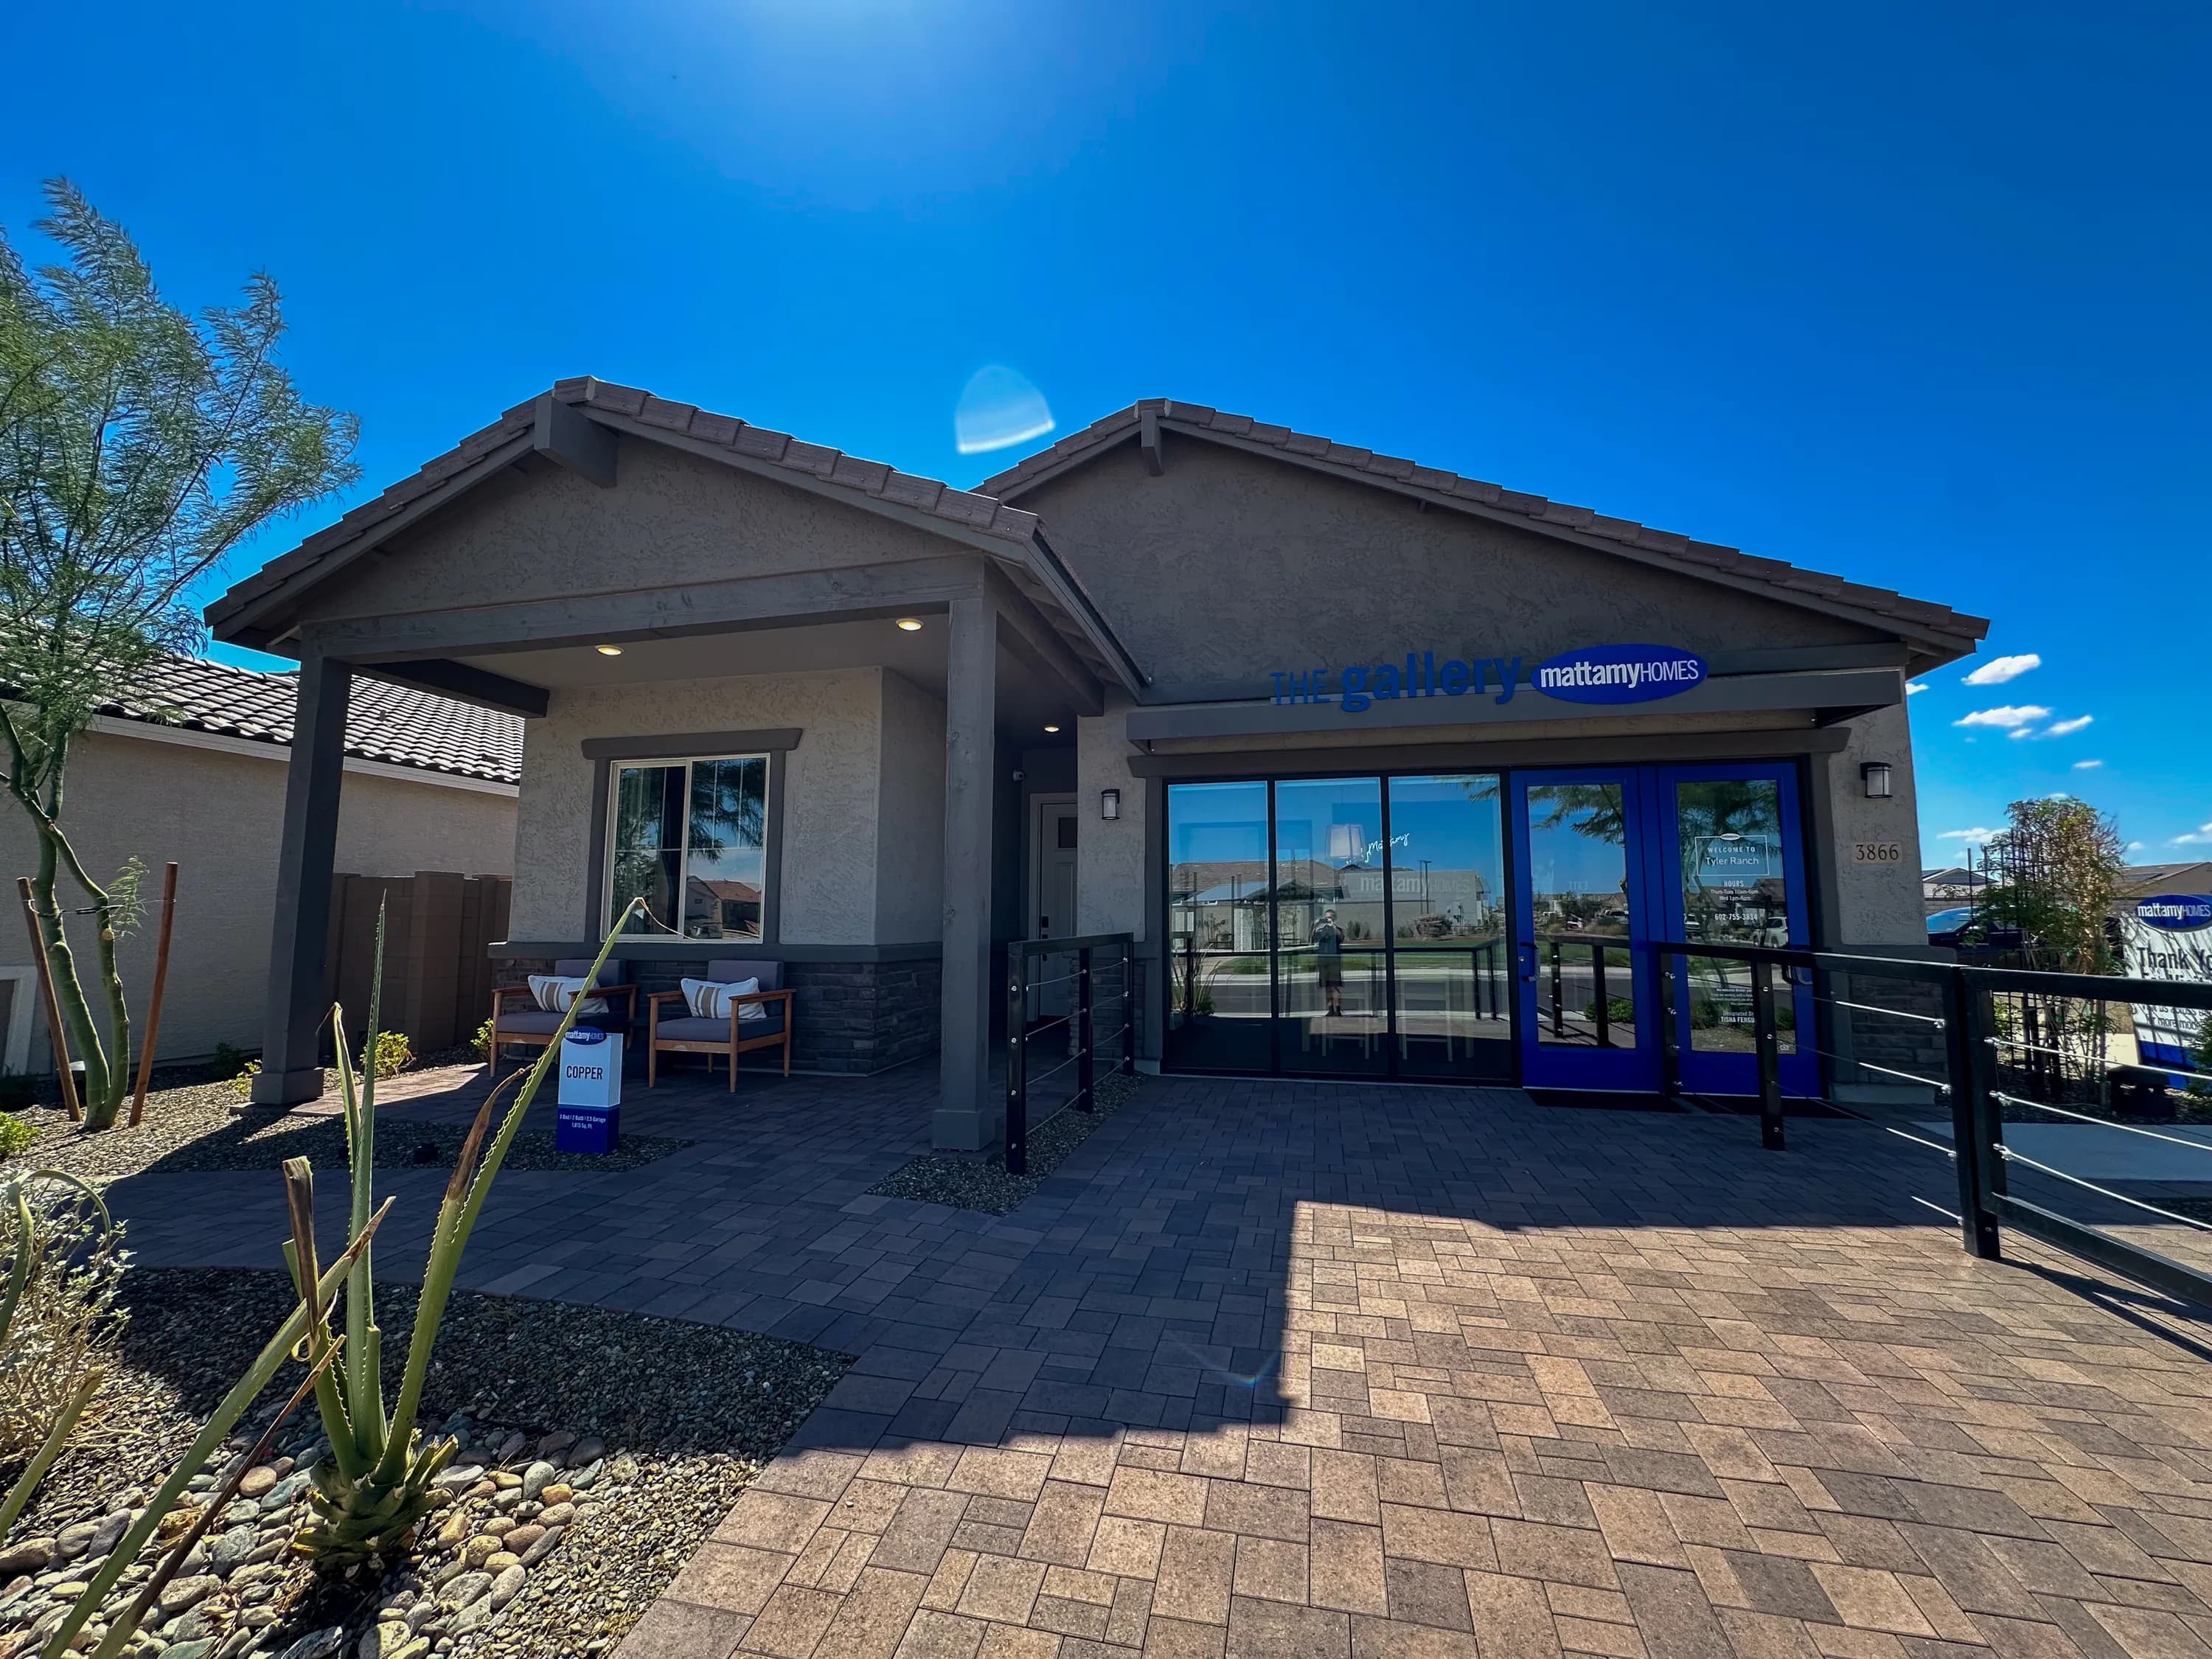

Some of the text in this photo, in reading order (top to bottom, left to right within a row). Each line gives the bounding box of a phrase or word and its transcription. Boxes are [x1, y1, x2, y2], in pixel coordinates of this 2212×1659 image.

[1270, 652, 1521, 712] THE gallery
[1540, 660, 1699, 688] mattamyHOMES
[1856, 844, 1899, 860] 3866
[1705, 857, 1759, 867] Tyler Ranch
[1723, 880, 1745, 888] HOURS
[2138, 903, 2211, 920] mattamyHOMES
[2137, 947, 2212, 970] Thank Yo
[566, 1065, 603, 1080] COPPER
